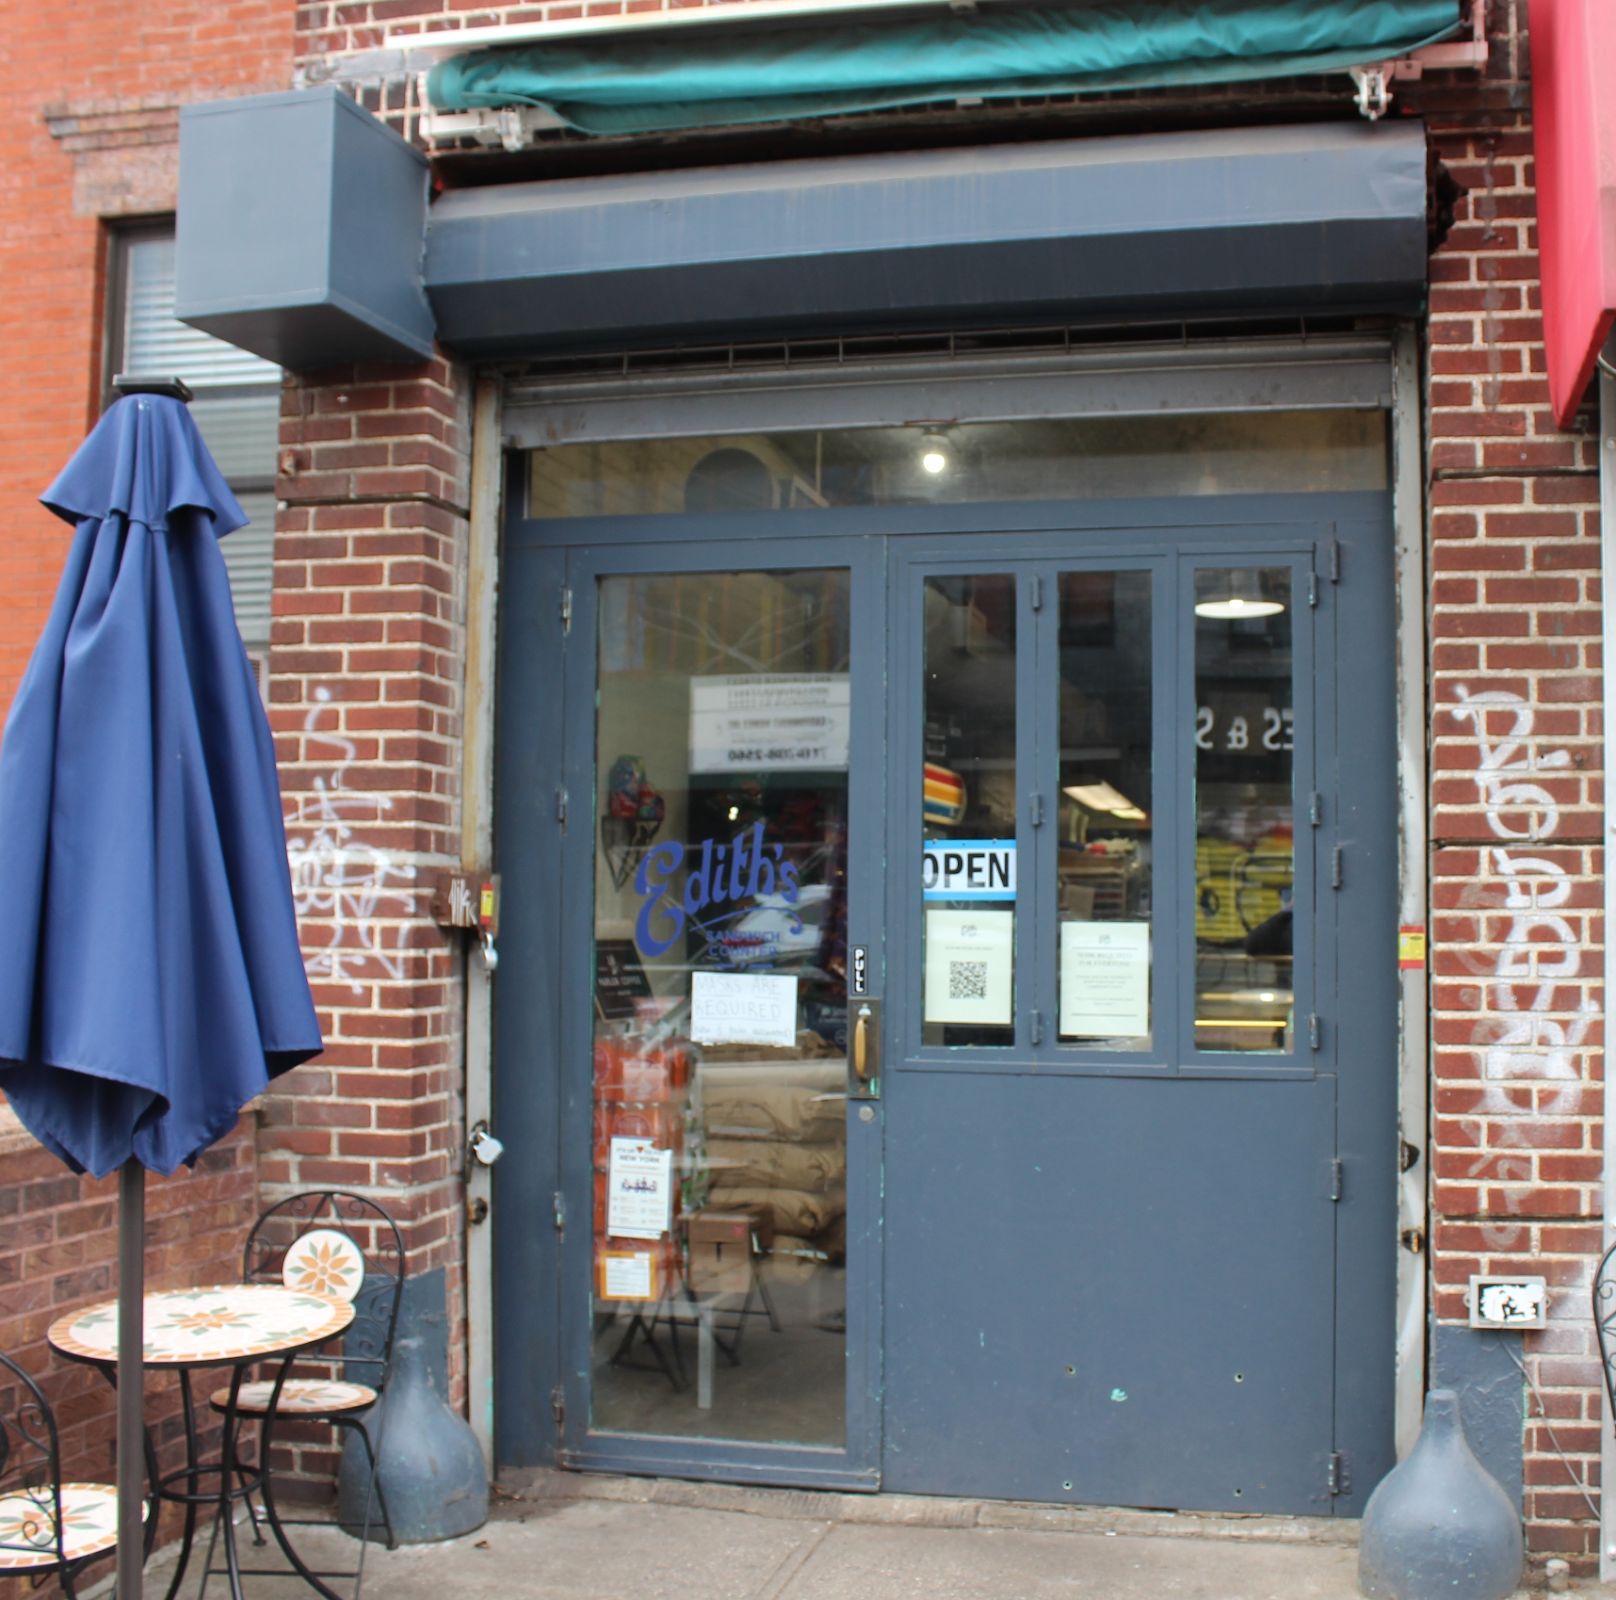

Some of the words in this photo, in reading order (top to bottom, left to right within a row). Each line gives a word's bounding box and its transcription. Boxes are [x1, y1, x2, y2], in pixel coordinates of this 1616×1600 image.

[923, 852, 1010, 889] OPEN
[634, 822, 798, 957] Edith's
[705, 930, 781, 943] SANDWICH
[709, 945, 778, 957] COUNTER
[855, 948, 865, 993] PULL
[752, 977, 781, 995] ARE
[694, 999, 782, 1018] REQUIRED
